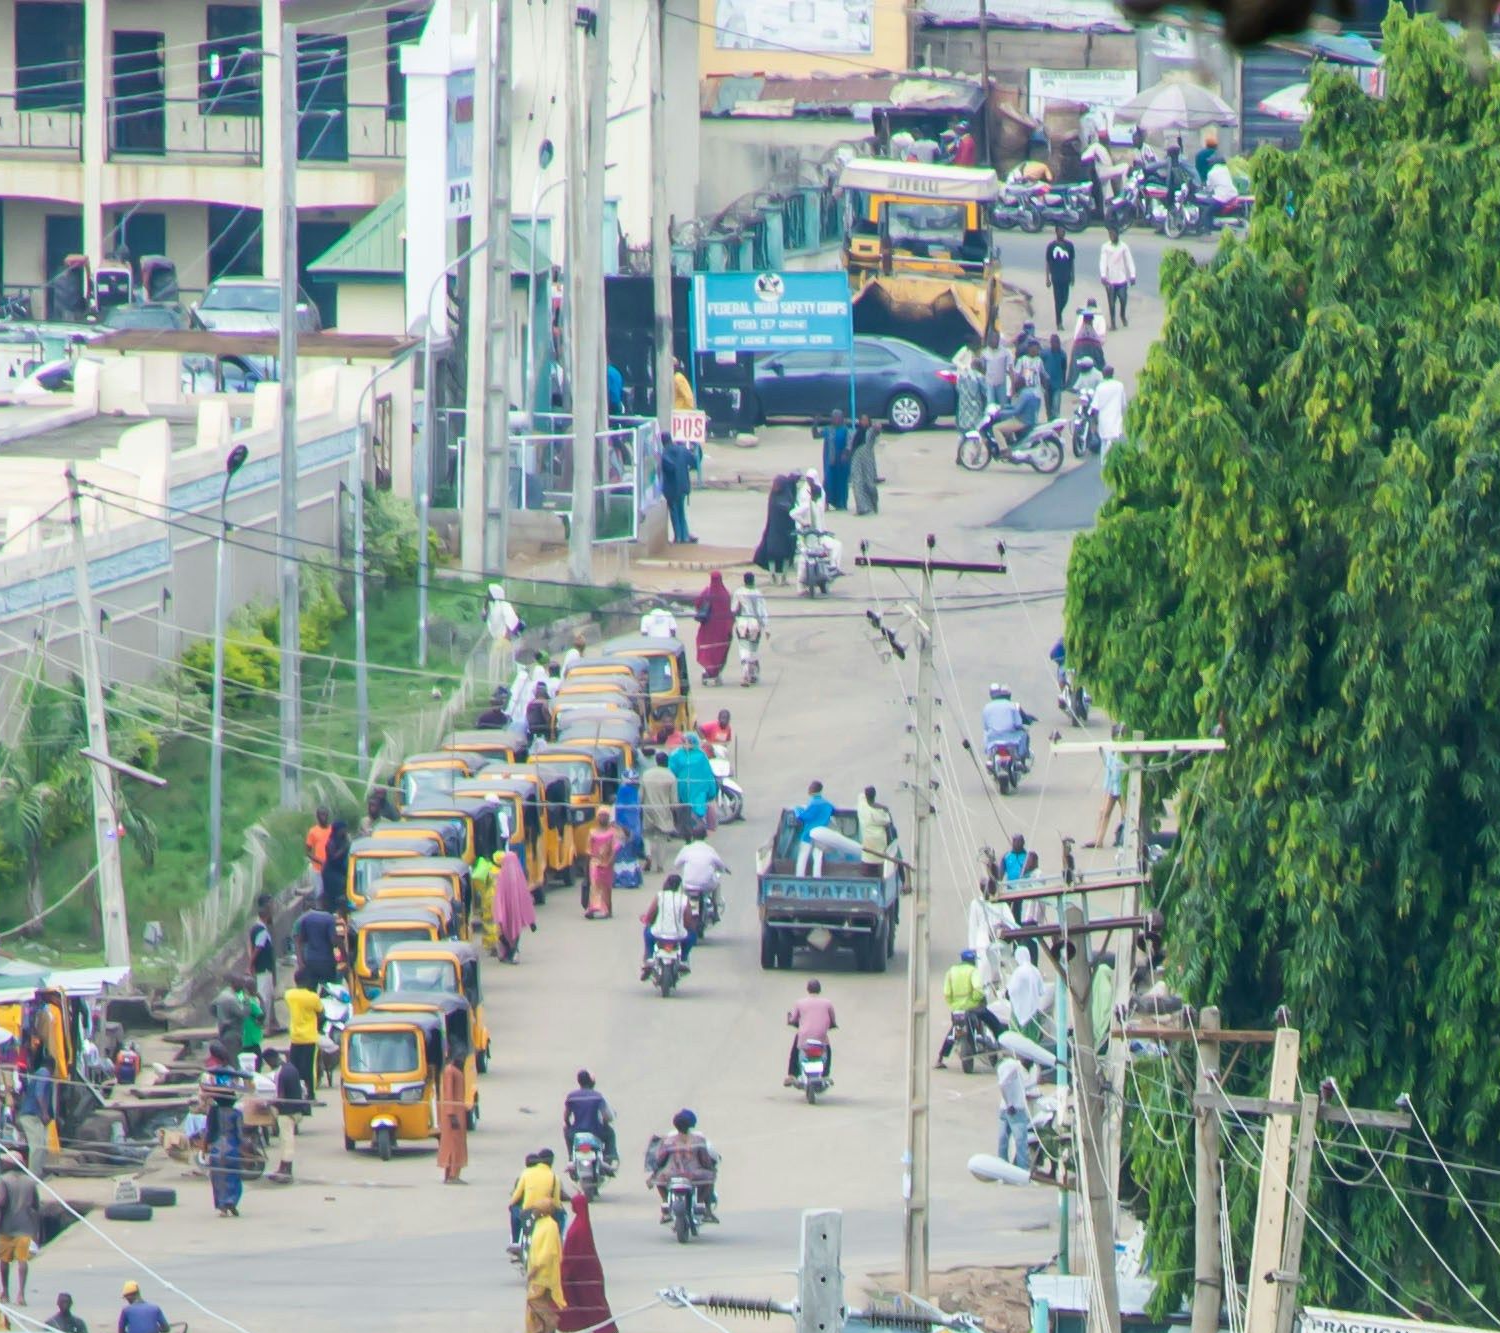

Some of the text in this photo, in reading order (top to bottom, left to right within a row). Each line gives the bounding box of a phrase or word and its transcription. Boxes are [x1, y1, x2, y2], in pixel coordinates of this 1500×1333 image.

[780, 301, 815, 315] SAFETY
[817, 302, 847, 315] CORPS
[673, 417, 703, 438] POS
